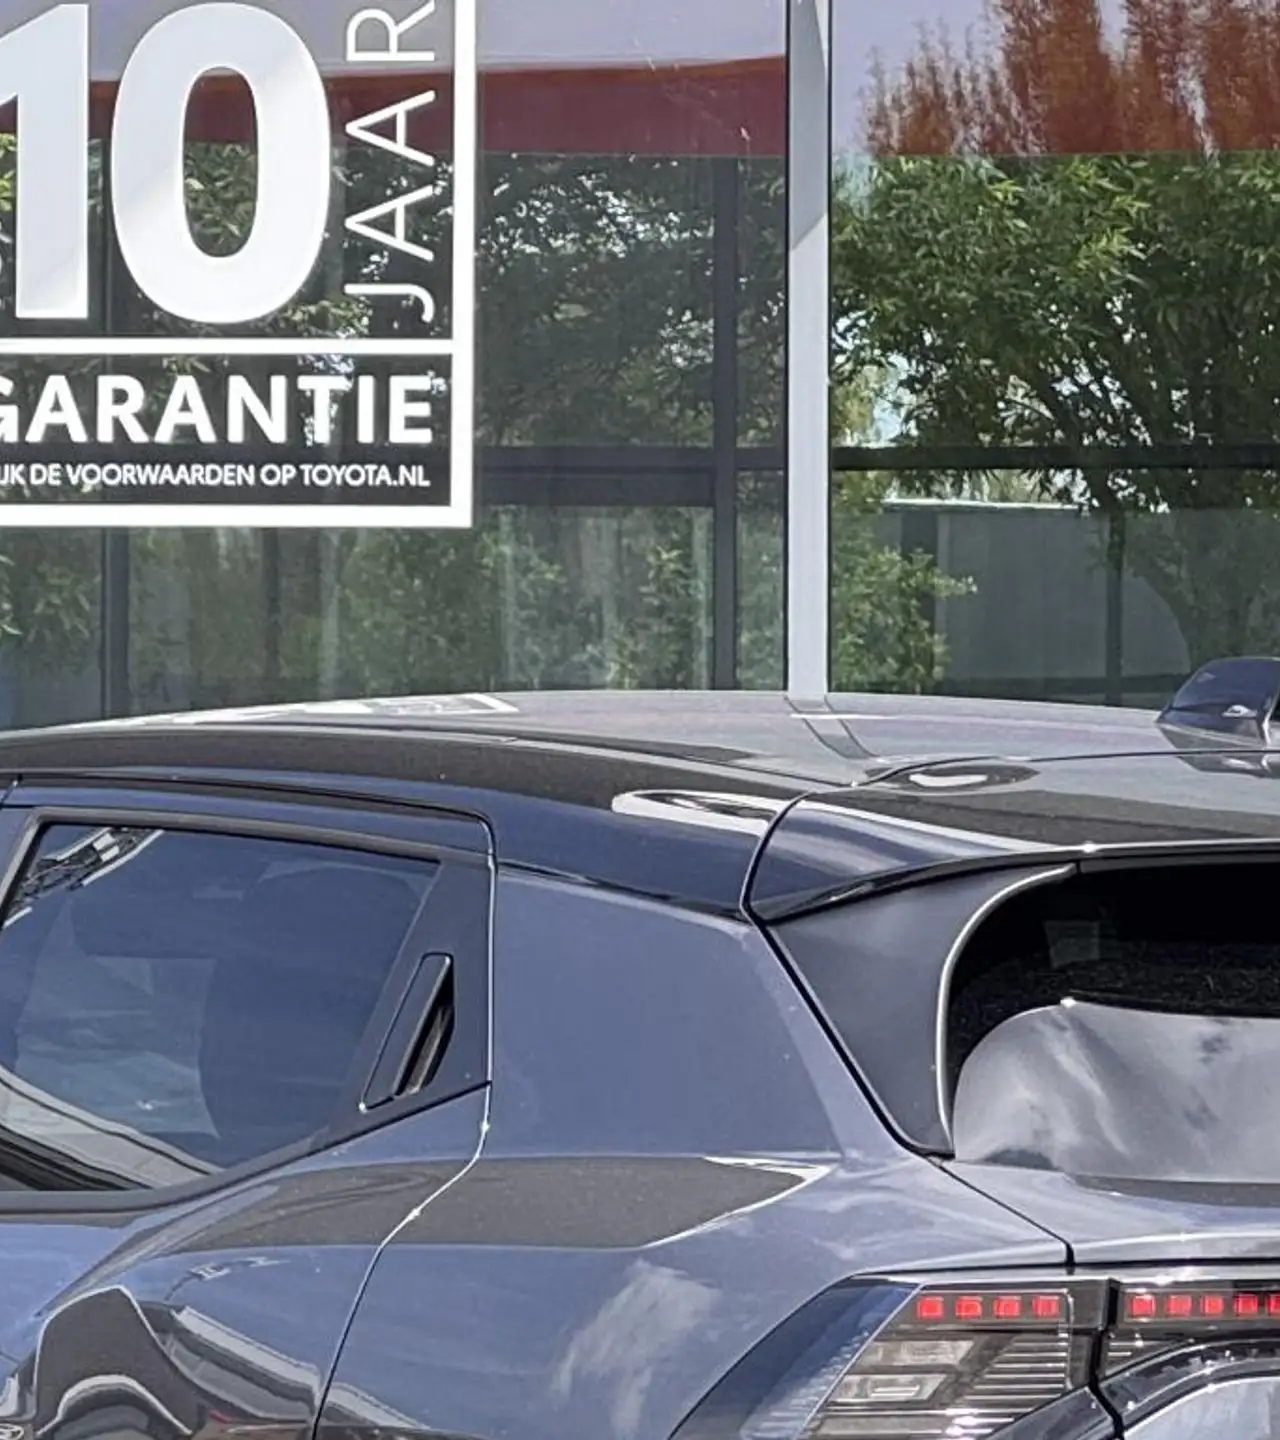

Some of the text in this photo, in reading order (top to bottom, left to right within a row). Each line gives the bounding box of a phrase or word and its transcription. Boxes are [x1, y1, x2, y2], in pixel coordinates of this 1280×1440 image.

[345, 0, 436, 323] JAAR
[30, 463, 61, 486] DE
[67, 464, 255, 486] VOORWAARDEN
[260, 464, 296, 486] OP
[303, 464, 431, 487] TOYOTA.NL
